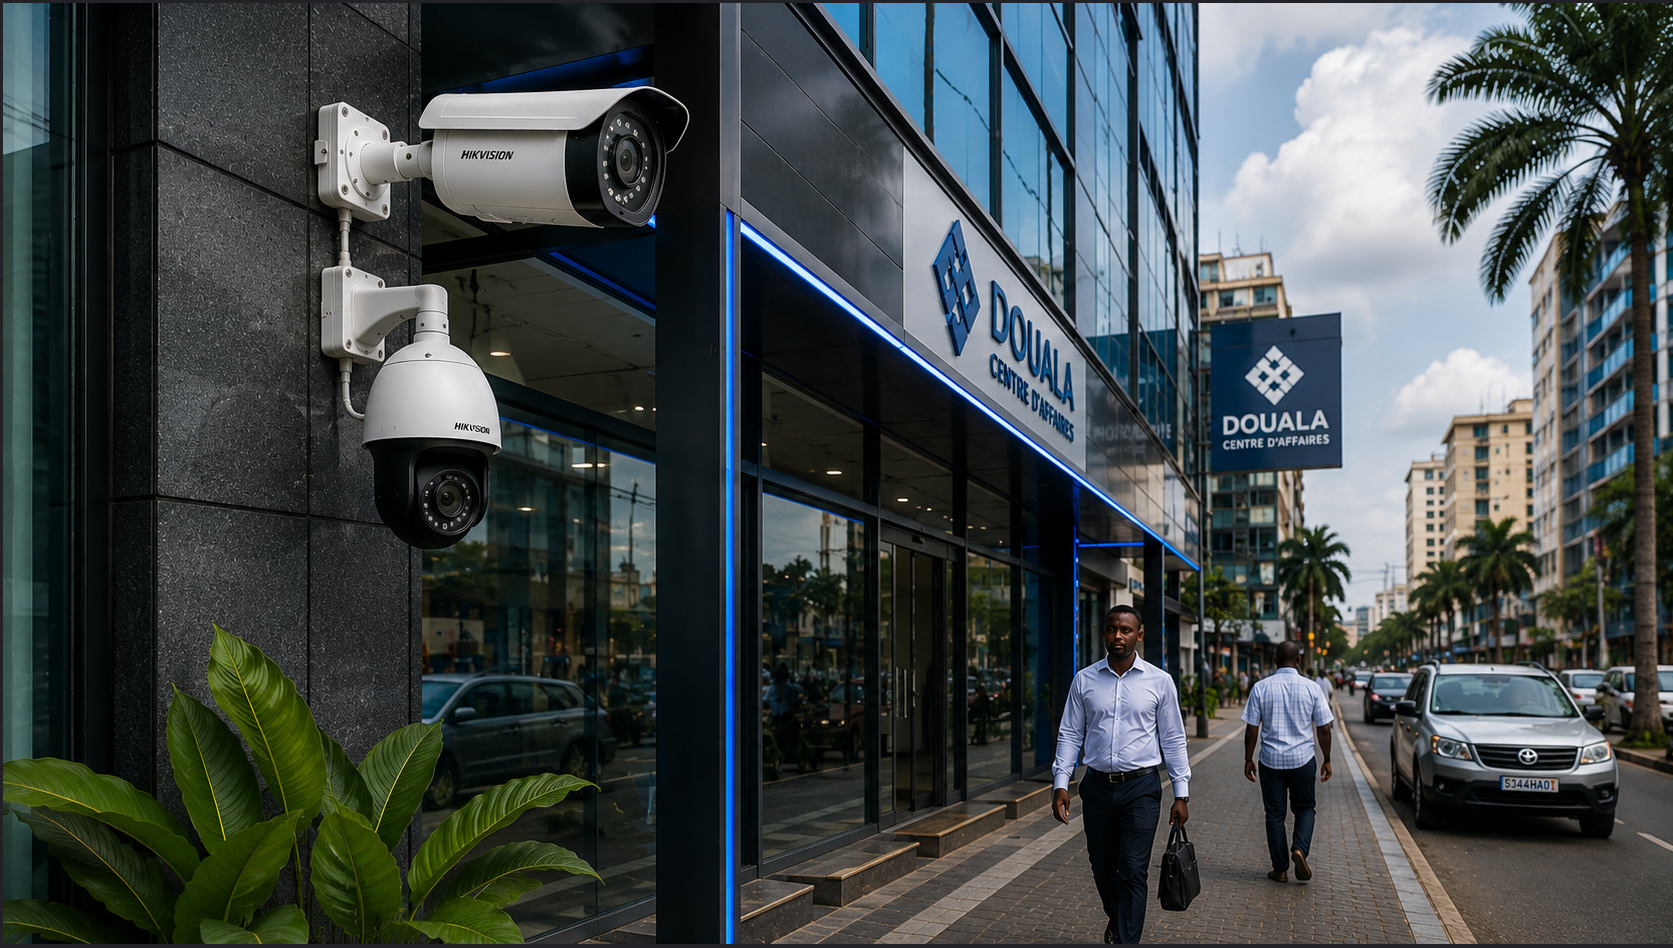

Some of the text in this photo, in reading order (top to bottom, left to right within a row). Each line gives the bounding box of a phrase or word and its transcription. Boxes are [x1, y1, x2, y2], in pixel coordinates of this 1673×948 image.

[461, 150, 514, 160] HIKVISION
[990, 280, 1075, 412] DOUALA
[989, 353, 1075, 443] CENTRE D'AFFAIRES
[1222, 409, 1330, 436] DOUALA
[1222, 433, 1330, 451] CENTRE D'AFFAIRES
